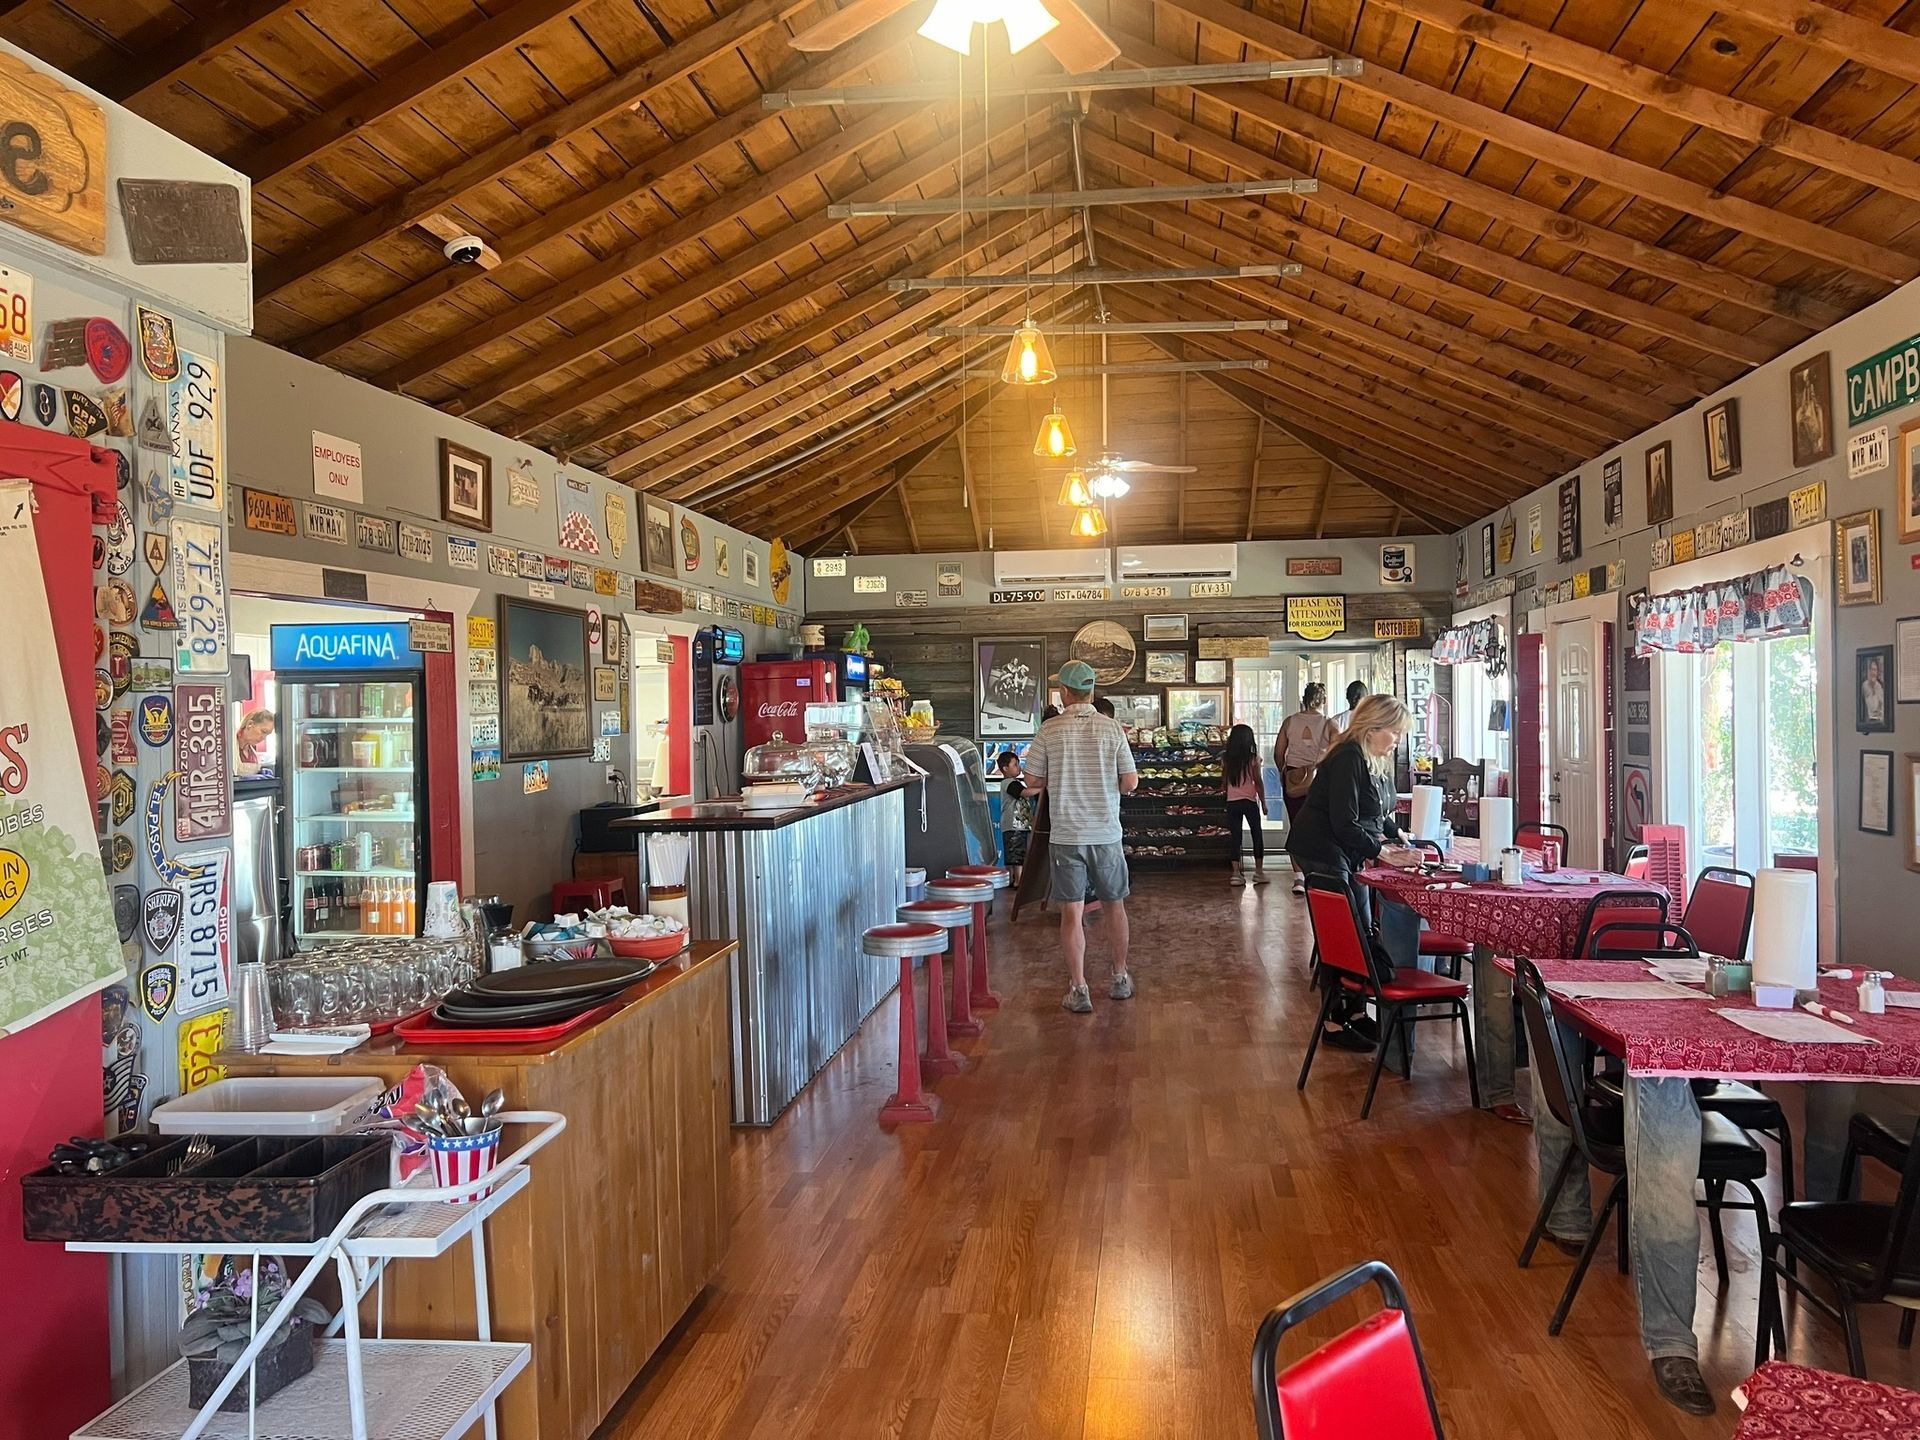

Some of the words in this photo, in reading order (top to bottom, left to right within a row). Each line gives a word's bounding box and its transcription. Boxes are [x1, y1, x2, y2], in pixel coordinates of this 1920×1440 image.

[187, 362, 214, 421] 929
[1850, 347, 1920, 417] CAMPB
[171, 391, 181, 458] KANSAS
[1858, 432, 1876, 446] TEXAS
[314, 445, 360, 468] EMPLOYEES
[189, 440, 215, 499] UDF
[328, 471, 349, 486] ONLY
[173, 481, 186, 497] HP
[316, 506, 334, 517] TEXAS
[213, 558, 222, 596] OCEAN
[187, 540, 217, 656] ZF-628
[938, 586, 961, 597] BETSY
[1289, 598, 1323, 608] PLEASE
[1325, 598, 1342, 607] ASK
[215, 607, 226, 641] STATE
[1289, 609, 1342, 619] ATTENDANT
[1377, 622, 1402, 635] POSTED
[295, 632, 396, 661] AQUAFINA
[1407, 660, 1430, 676] Hey
[179, 729, 189, 797] ARIZONA
[188, 694, 220, 828] 4HR-395
[216, 737, 225, 779] CANYON
[150, 791, 161, 809] EL
[218, 780, 226, 817] GRAND
[148, 815, 162, 859] PASO,
[3, 859, 20, 880] IN
[156, 859, 171, 880] TX
[190, 861, 217, 917] HRS
[146, 894, 178, 911] SHERIFF
[219, 906, 229, 944] OHIO
[11, 947, 30, 963] WT.
[190, 924, 218, 999] 8715
[148, 968, 171, 979] FEDERAL
[150, 1006, 167, 1016] POLICE
